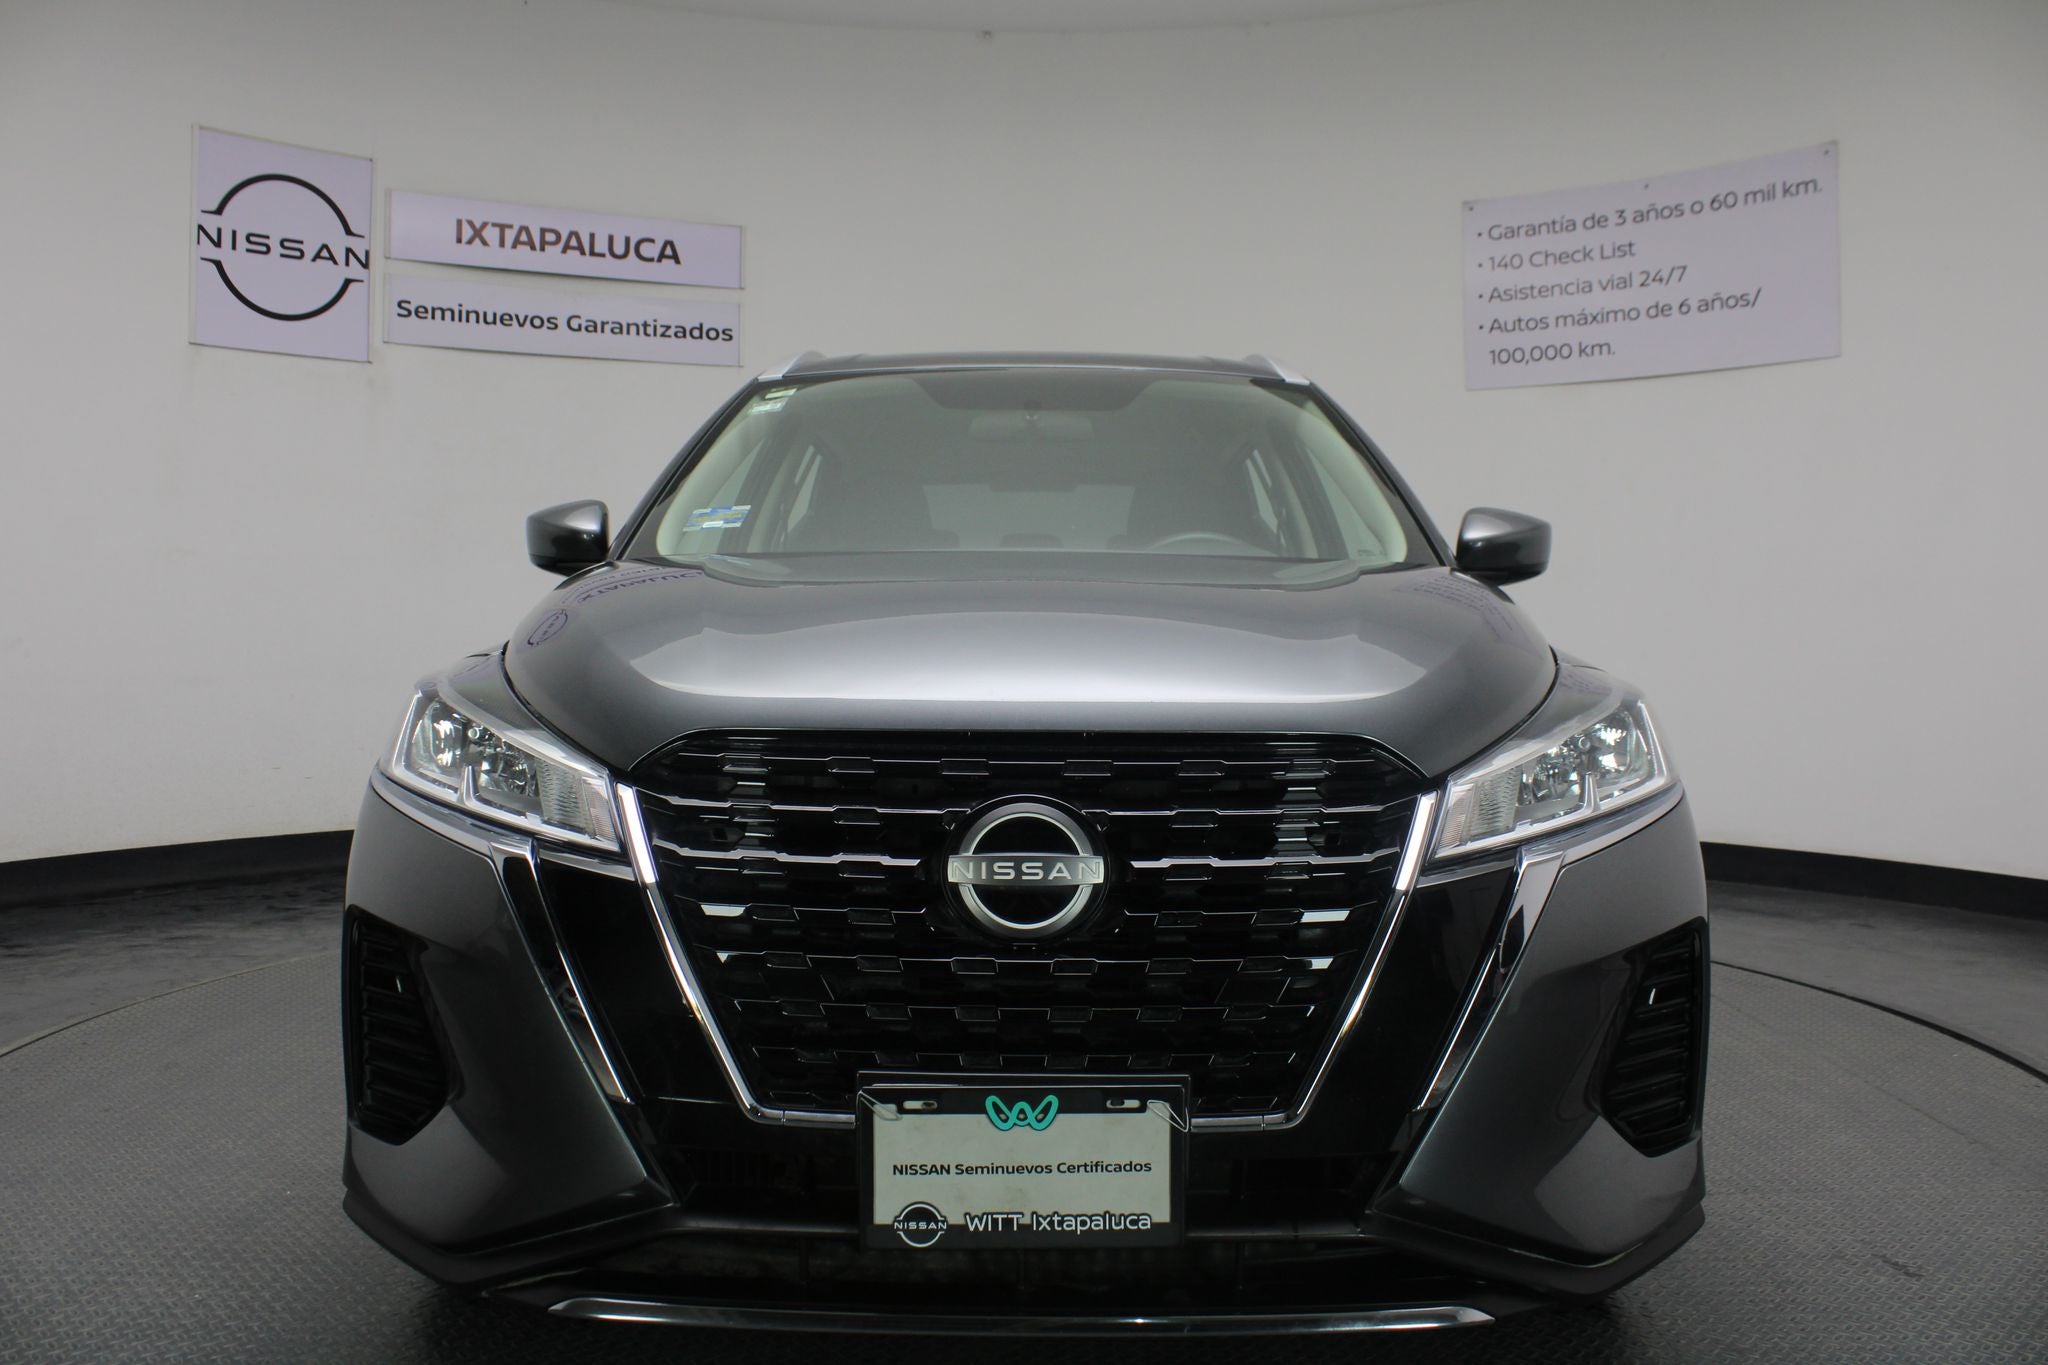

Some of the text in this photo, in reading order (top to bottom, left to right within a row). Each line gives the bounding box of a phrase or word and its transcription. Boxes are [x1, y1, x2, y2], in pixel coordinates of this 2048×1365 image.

[1488, 178, 1823, 241] Garantía de 3 años o 60 mil km.
[197, 223, 370, 270] NISSAN
[455, 217, 682, 266] IXTAPALUCA
[1489, 240, 1636, 271] 140 Check List
[1488, 265, 1688, 303] Asistencia vial 24/7
[396, 299, 734, 343] Seminuevos Garantizados
[1488, 287, 1762, 334] Autos máximo de 6 años/
[1489, 340, 1616, 367] 100,000 km.
[951, 861, 1101, 880] NISSAN
[893, 1160, 1153, 1176] NISSAN Seminuevos Certificados
[894, 1219, 948, 1231] NISSAN
[964, 1212, 1153, 1236] WITT Ixtapaluca
